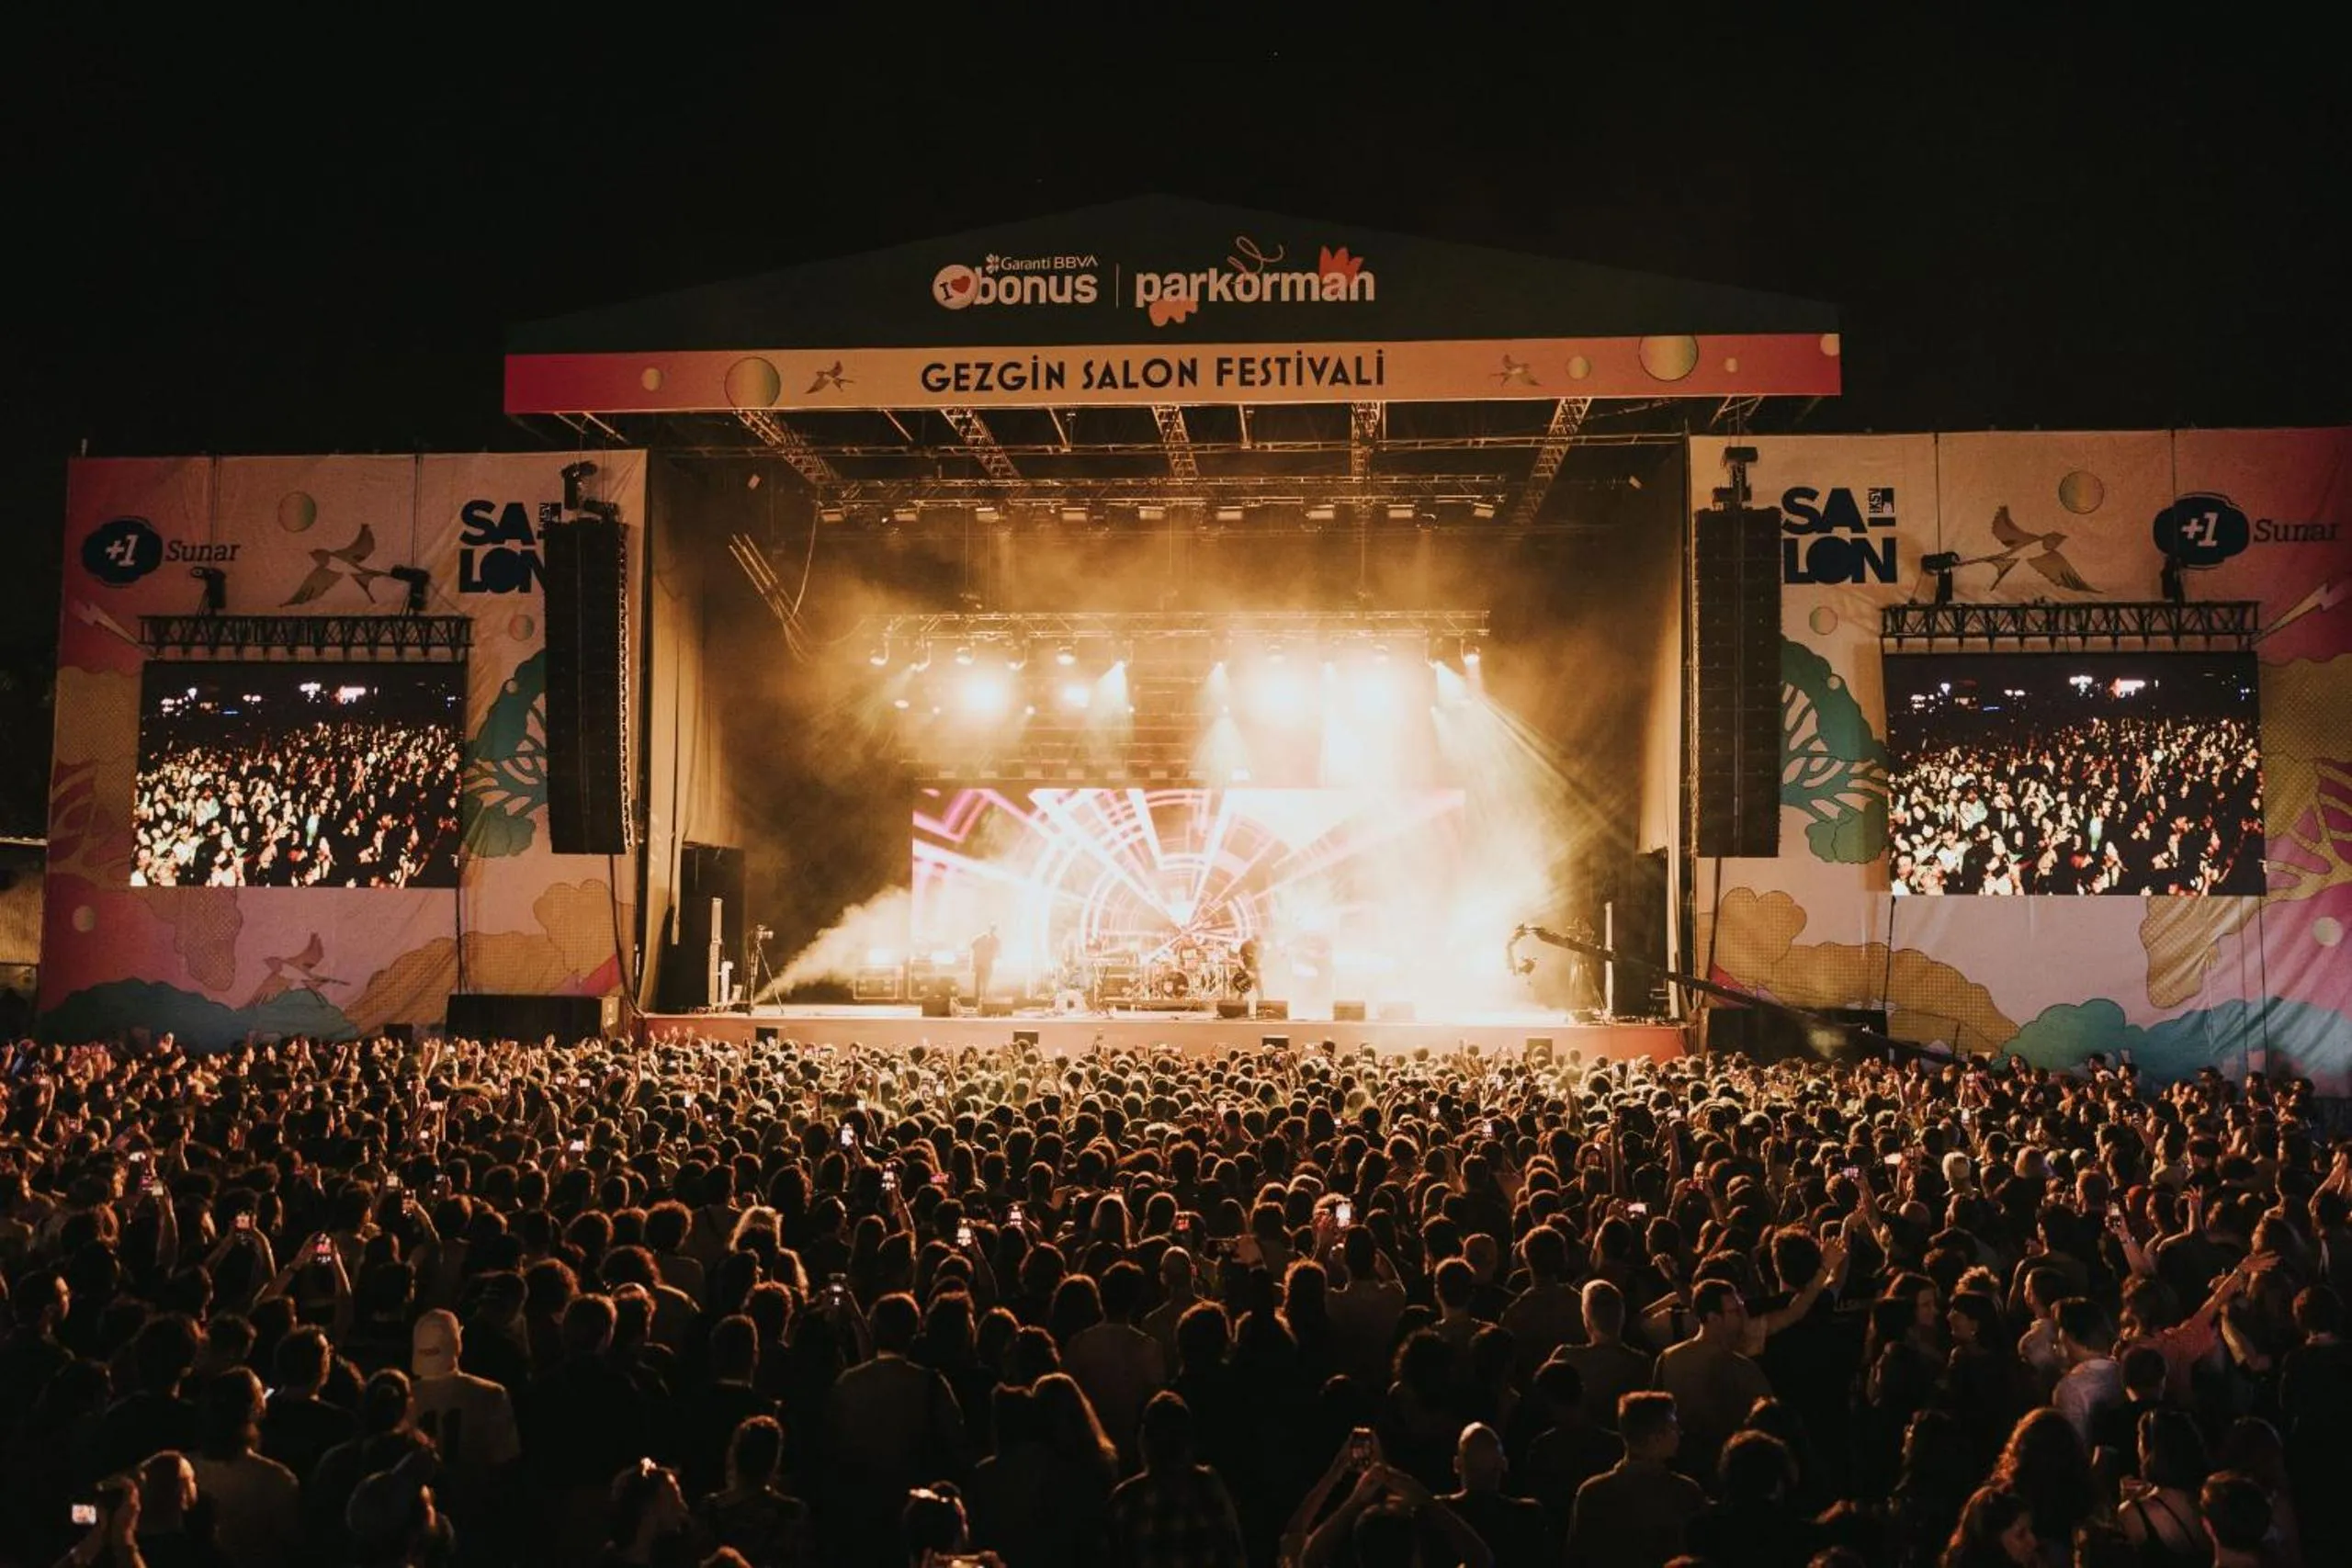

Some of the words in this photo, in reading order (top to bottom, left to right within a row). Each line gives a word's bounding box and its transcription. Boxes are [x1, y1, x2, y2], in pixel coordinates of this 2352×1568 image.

[1001, 256, 1051, 271] Garanti
[1054, 254, 1099, 269] BBVA
[974, 266, 1098, 305] bonus
[1135, 267, 1375, 309] parkorman
[922, 355, 1066, 393] GEZGİN
[1082, 358, 1198, 390] SALON
[1216, 348, 1385, 388] FESTİVALİ
[2181, 512, 2219, 547] +1
[2253, 518, 2340, 543] Sunar
[105, 534, 139, 567] +1
[165, 539, 242, 562] Sunar
